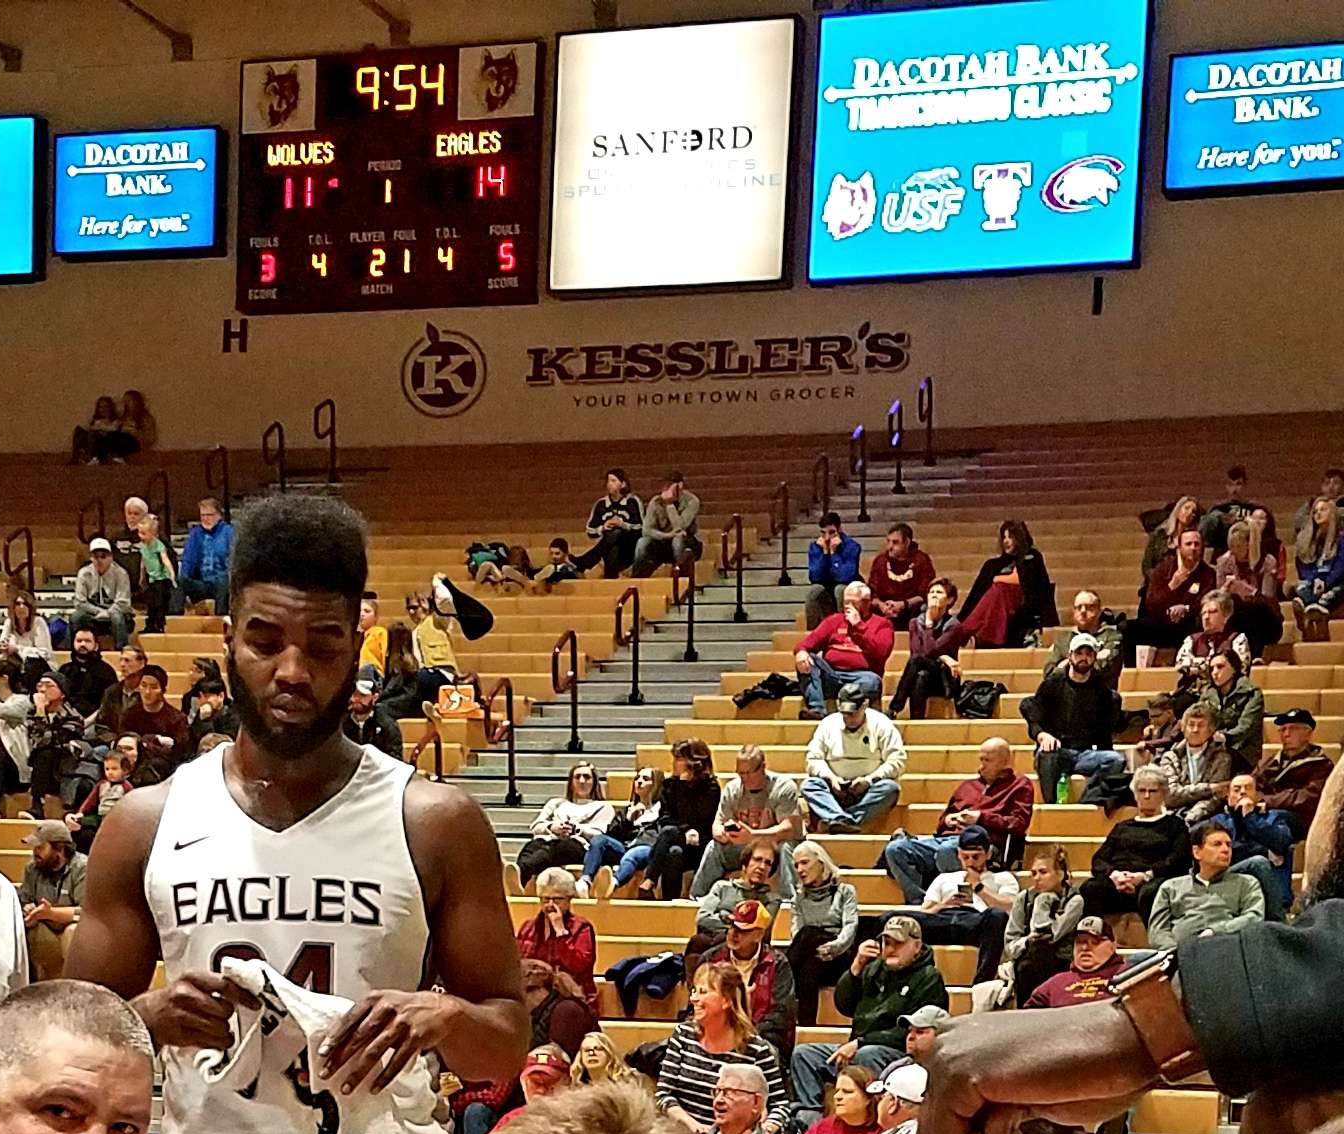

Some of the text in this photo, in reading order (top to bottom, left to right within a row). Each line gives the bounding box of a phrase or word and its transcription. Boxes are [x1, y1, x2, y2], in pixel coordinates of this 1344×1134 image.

[853, 42, 1111, 88] DACOTAH BANK
[1208, 58, 1343, 90] DACOTAH
[356, 63, 445, 111] 9:54
[84, 142, 189, 166] DACOTAH
[267, 141, 335, 167] WOLVES
[436, 130, 502, 157] EAGLES
[1197, 146, 1251, 169] Here
[1248, 142, 1285, 171] for
[285, 176, 312, 208] 11
[385, 178, 391, 203] 1
[478, 166, 506, 196] 14
[882, 186, 966, 232] USF
[79, 216, 118, 236] Here
[117, 214, 147, 239] for
[350, 231, 385, 243] PLAYER
[261, 254, 276, 283] 3
[312, 252, 327, 277] 4
[438, 246, 453, 271] 4
[499, 242, 515, 271] 5
[223, 319, 248, 353] H
[526, 321, 910, 386] KESSLER'S
[573, 386, 855, 407] YOUR HOMETOWN GROCER
[172, 875, 383, 927] EAGLES
